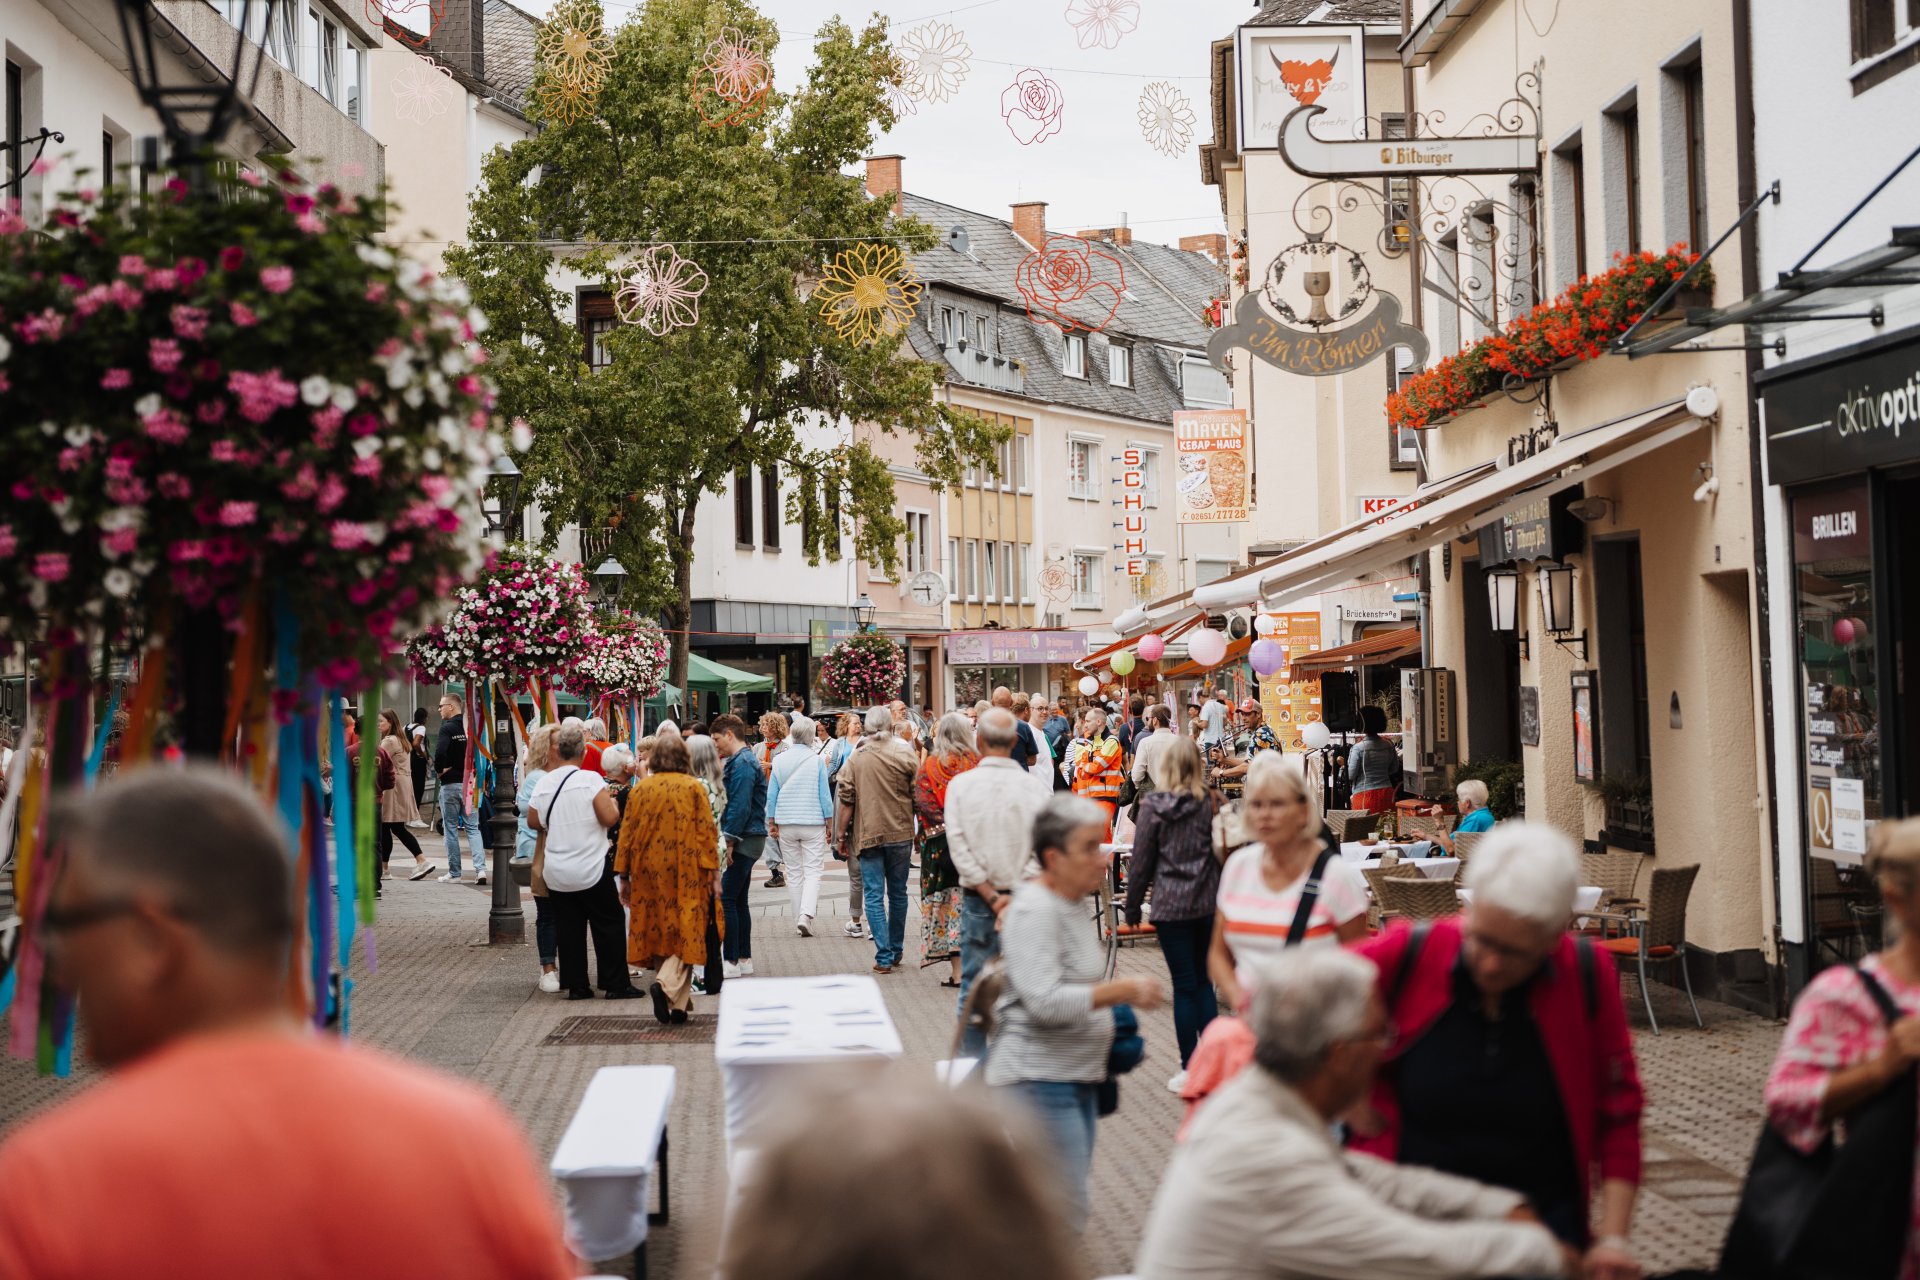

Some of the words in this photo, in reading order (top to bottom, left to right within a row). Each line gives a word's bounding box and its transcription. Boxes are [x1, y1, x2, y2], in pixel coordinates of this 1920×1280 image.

[1396, 147, 1454, 167] Bitburger
[1179, 420, 1242, 439] MAYEN
[1124, 450, 1143, 576] SCHUHE
[1812, 510, 1857, 541] BRILLEN
